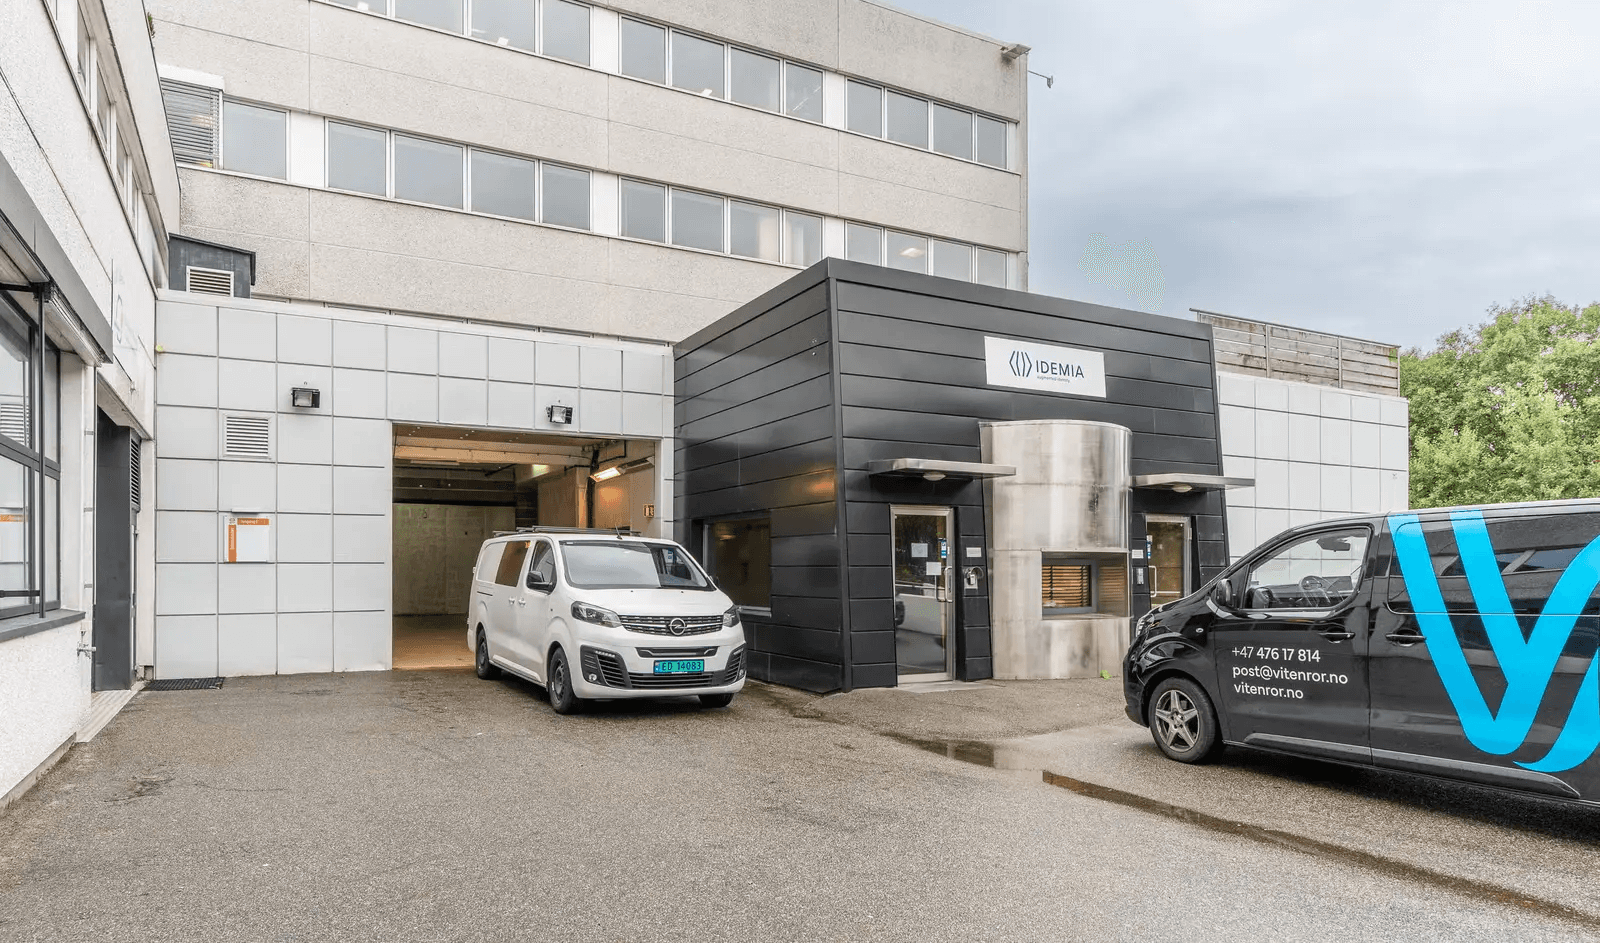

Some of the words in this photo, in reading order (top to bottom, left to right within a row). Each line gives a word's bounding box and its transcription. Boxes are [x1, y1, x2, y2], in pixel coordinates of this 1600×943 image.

[1036, 360, 1085, 378] IDEMIA
[1231, 646, 1254, 659] +47
[1256, 647, 1280, 660] 476
[1282, 648, 1295, 661] 17
[1298, 649, 1321, 663] 814
[662, 662, 673, 671] ED
[677, 662, 701, 671] 14083
[1232, 665, 1348, 684] post@vitenror.no
[1233, 681, 1304, 699] vitenror.no
